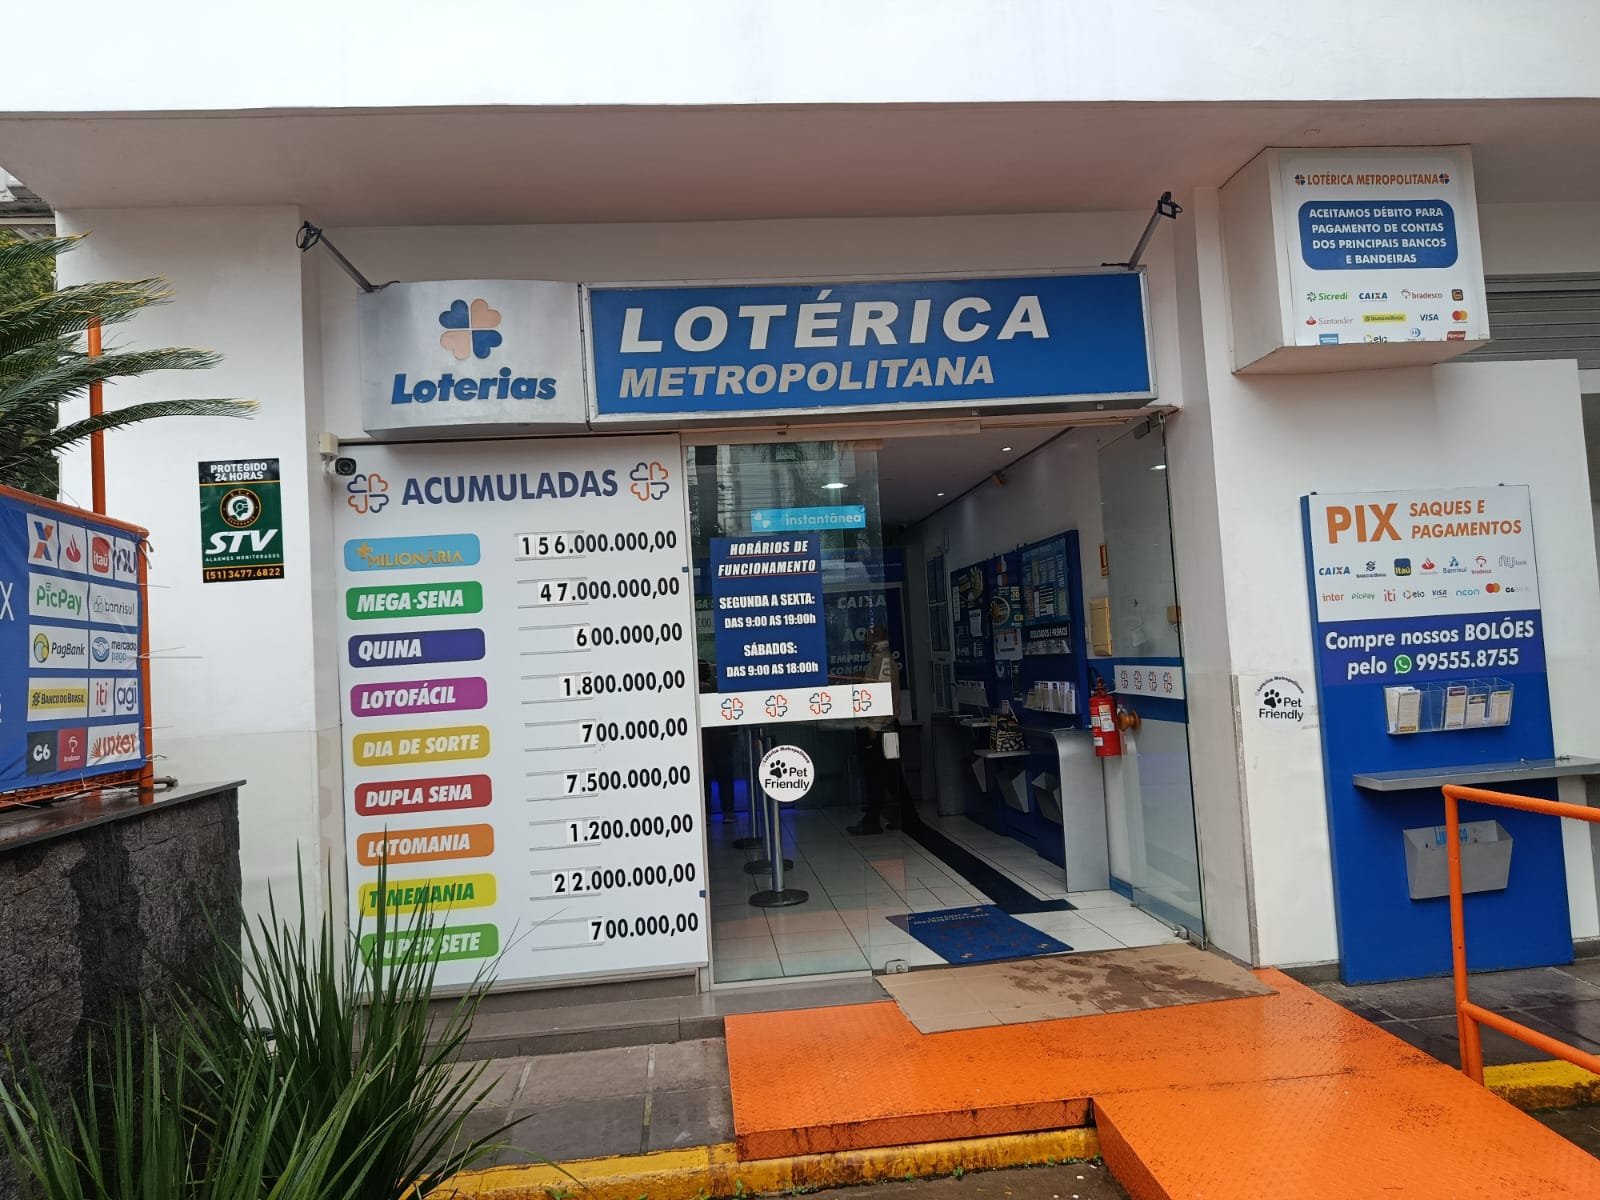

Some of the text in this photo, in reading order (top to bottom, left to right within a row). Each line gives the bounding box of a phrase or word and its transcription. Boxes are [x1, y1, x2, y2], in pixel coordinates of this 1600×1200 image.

[1307, 171, 1439, 186] LOTÉRICA METROPOLITANA
[1309, 206, 1444, 218] ACEITAMOS DÉBITO PARA
[1312, 222, 1444, 234] PAGAMENTO DE CONTAS
[1312, 238, 1447, 249] DOS PRINCIPAIS BANCOS
[1346, 254, 1417, 264] E BANDEIRAS
[1318, 292, 1348, 301] Sicredi
[1359, 292, 1388, 300] CAIXA
[1411, 291, 1443, 299] bradesco
[619, 289, 1049, 354] LOTÉRICA
[1420, 313, 1439, 321] VISA
[391, 367, 557, 405] Loterias
[619, 355, 994, 399] METROPOLITANA
[210, 462, 268, 473] PROTEGIDO
[215, 471, 264, 482] 24 HORAS
[401, 469, 618, 506] ACUMULADAS
[1409, 499, 1485, 517] SAQUES E
[785, 511, 861, 526] instantânea
[1325, 502, 1402, 544] PIX
[1411, 520, 1522, 539] PAGAMENTOS
[205, 529, 279, 555] STV
[521, 530, 677, 556] 156.000.000,00
[729, 540, 808, 556] HORÁRIOS DE
[92, 551, 108, 567] itaú
[718, 559, 816, 577] FUNCIONAMENTO
[1318, 566, 1351, 576] CAIXA
[540, 577, 680, 602] 47.000.000,00
[1322, 593, 1345, 602] inter
[1351, 592, 1375, 601] PicPay
[1384, 590, 1396, 602] iti
[36, 583, 82, 615] PicPay
[104, 596, 135, 617] banrisul
[356, 589, 464, 613] MEGA-SENA
[719, 593, 768, 609] SEGUNDA
[771, 594, 779, 606] A
[780, 592, 815, 606] SEXTA:
[724, 616, 744, 629] DAS
[745, 615, 768, 628] 9:00
[769, 614, 782, 627] AS
[783, 612, 816, 626] 19:00h
[576, 622, 683, 648] 600.000,00
[1325, 616, 1535, 652] Compre nossos BOLÕES
[51, 641, 86, 659] PagBank
[111, 640, 137, 652] mercado
[359, 639, 422, 661] QUINA
[743, 640, 797, 657] SÁBADOS:
[726, 662, 819, 678] DAS 9:00 AS 18:00h
[1347, 647, 1520, 680] pelo 99555.8755
[563, 670, 685, 697] 1.800.000,00
[96, 681, 108, 706] iti
[117, 683, 137, 712] agi
[360, 683, 456, 710] LOTOFÁCIL
[1283, 697, 1302, 708] Pet
[1259, 708, 1304, 722] Friendly
[582, 717, 688, 743] 700.000,00
[33, 744, 51, 762] C6
[362, 733, 480, 759] DIA DE SORTE
[566, 765, 691, 794] 7.500.000,00
[789, 767, 808, 777] Pet
[764, 778, 810, 791] Friendly
[365, 783, 473, 808] DUPLA SENA
[569, 813, 693, 842] 1.200.000,00
[554, 862, 696, 894] 22.000.000,00
[369, 883, 475, 908] TMEMANIA
[591, 912, 699, 942] 700.000,00
[440, 932, 481, 954] SETE
